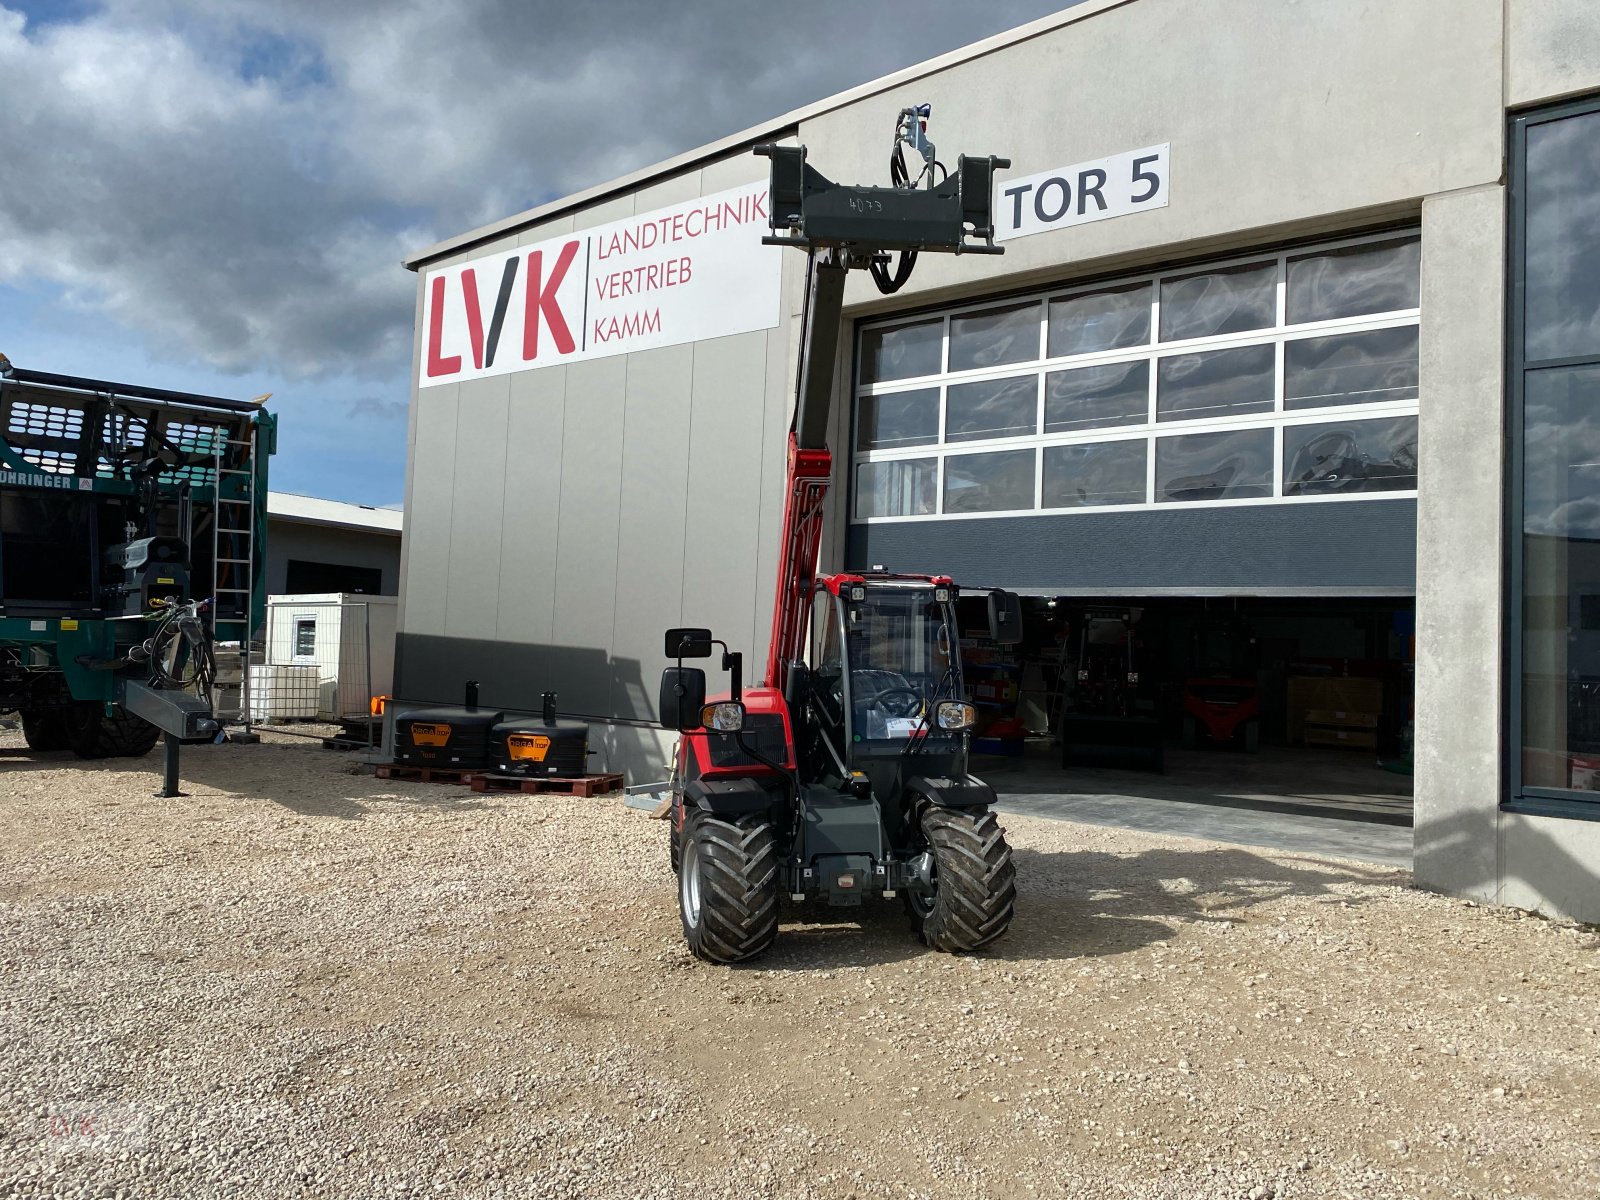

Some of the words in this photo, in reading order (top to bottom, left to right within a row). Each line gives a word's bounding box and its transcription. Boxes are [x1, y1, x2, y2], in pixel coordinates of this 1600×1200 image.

[850, 198, 882, 213] 4073
[1005, 168, 1107, 229] TOR
[1131, 154, 1160, 203] 5
[599, 191, 767, 260] LANDTECHNIK
[596, 257, 691, 300] VERTRIEB
[427, 241, 580, 377] LVK
[595, 308, 661, 344] KAMM
